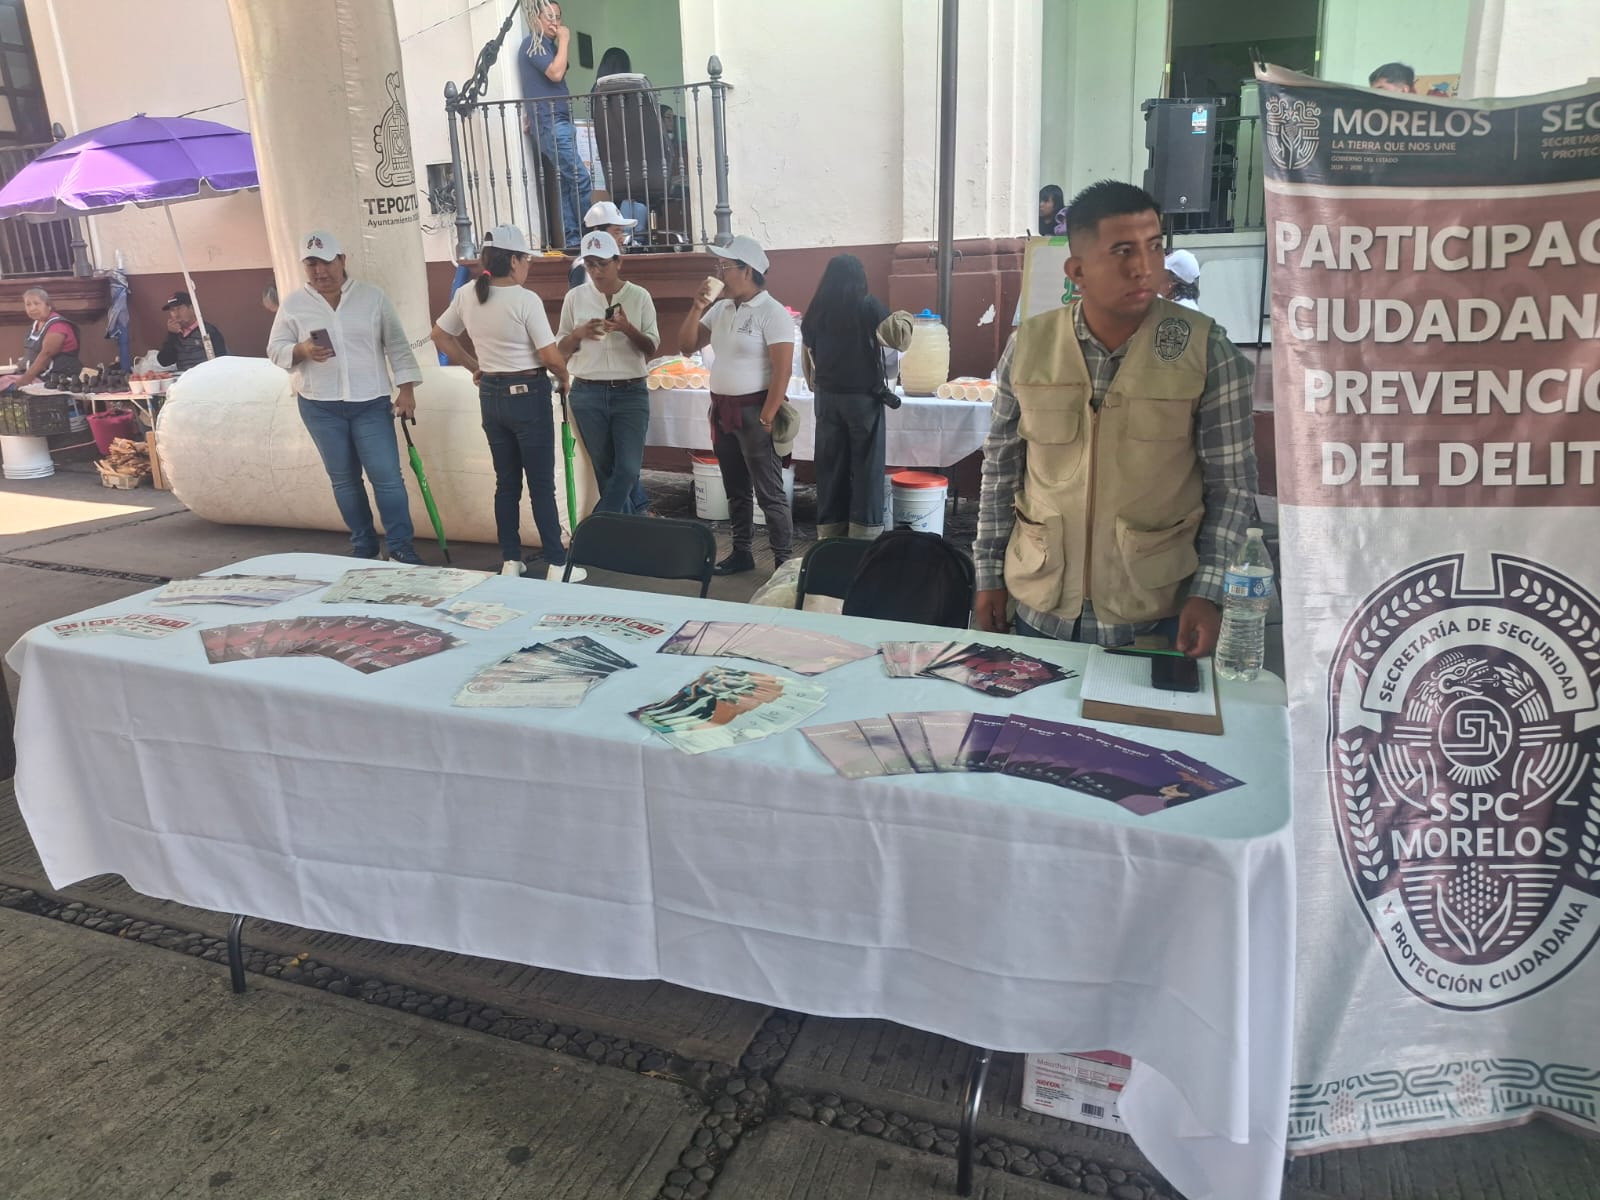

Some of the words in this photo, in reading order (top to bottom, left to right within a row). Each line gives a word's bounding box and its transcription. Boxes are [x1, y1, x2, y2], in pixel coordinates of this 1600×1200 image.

[1332, 107, 1492, 137] MORELOS
[1331, 140, 1344, 149] LA
[1348, 140, 1381, 150] TIERRA
[1384, 141, 1405, 151] QUE
[1408, 142, 1431, 151] NOS
[1434, 142, 1457, 151] UNE
[1540, 151, 1549, 160] Y
[1287, 293, 1600, 342] CIUDADAN
[1321, 441, 1420, 486] DEL
[1379, 619, 1461, 703] SECRETARÍA
[1466, 617, 1491, 632] DE
[1496, 620, 1578, 701] SEGURIDAD
[1430, 792, 1520, 822] SSPC
[1391, 827, 1569, 860] MORELOS
[1383, 901, 1397, 916] Y
[1390, 921, 1483, 993] PROTECCIÓN
[1488, 901, 1588, 990] CIUDADANA
